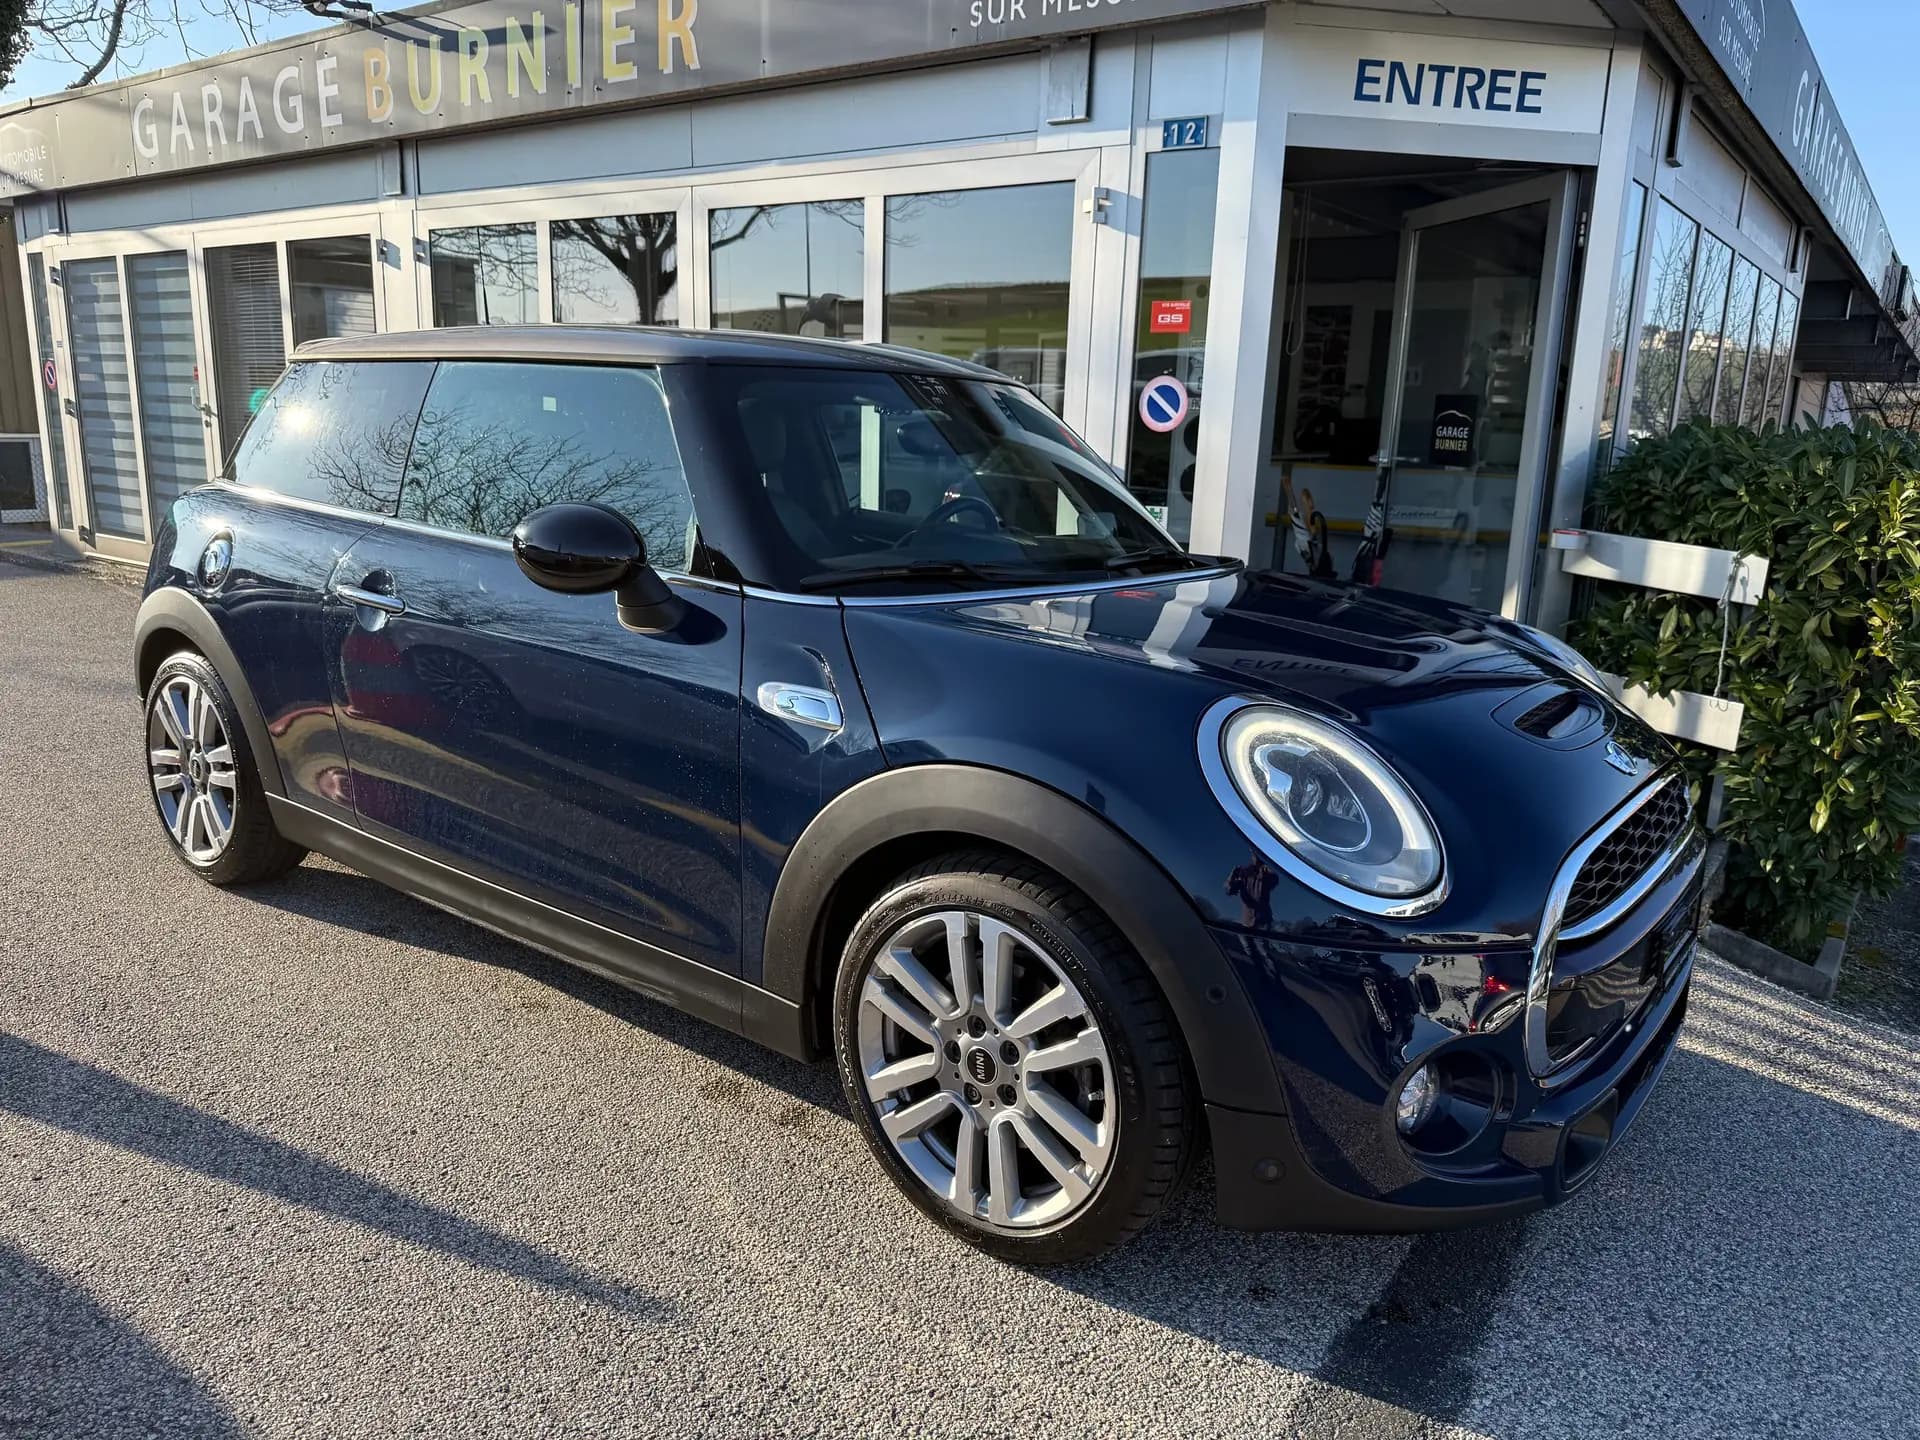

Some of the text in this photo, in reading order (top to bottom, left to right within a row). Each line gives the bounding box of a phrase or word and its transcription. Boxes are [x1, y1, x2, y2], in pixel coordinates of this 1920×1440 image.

[969, 0, 1027, 27] SUR
[1728, 0, 1761, 52] TOMOBILE
[132, 0, 701, 158] GARAGE BURNIER
[1353, 58, 1547, 113] ENTREE
[1171, 121, 1196, 145] 12
[1792, 69, 1844, 206] GARAGE
[2, 145, 47, 165] TOMOBILE
[1157, 313, 1184, 324] GS
[1434, 438, 1468, 452] BURNIER
[1436, 426, 1469, 439] GARAGE
[975, 1051, 986, 1080] MINI
